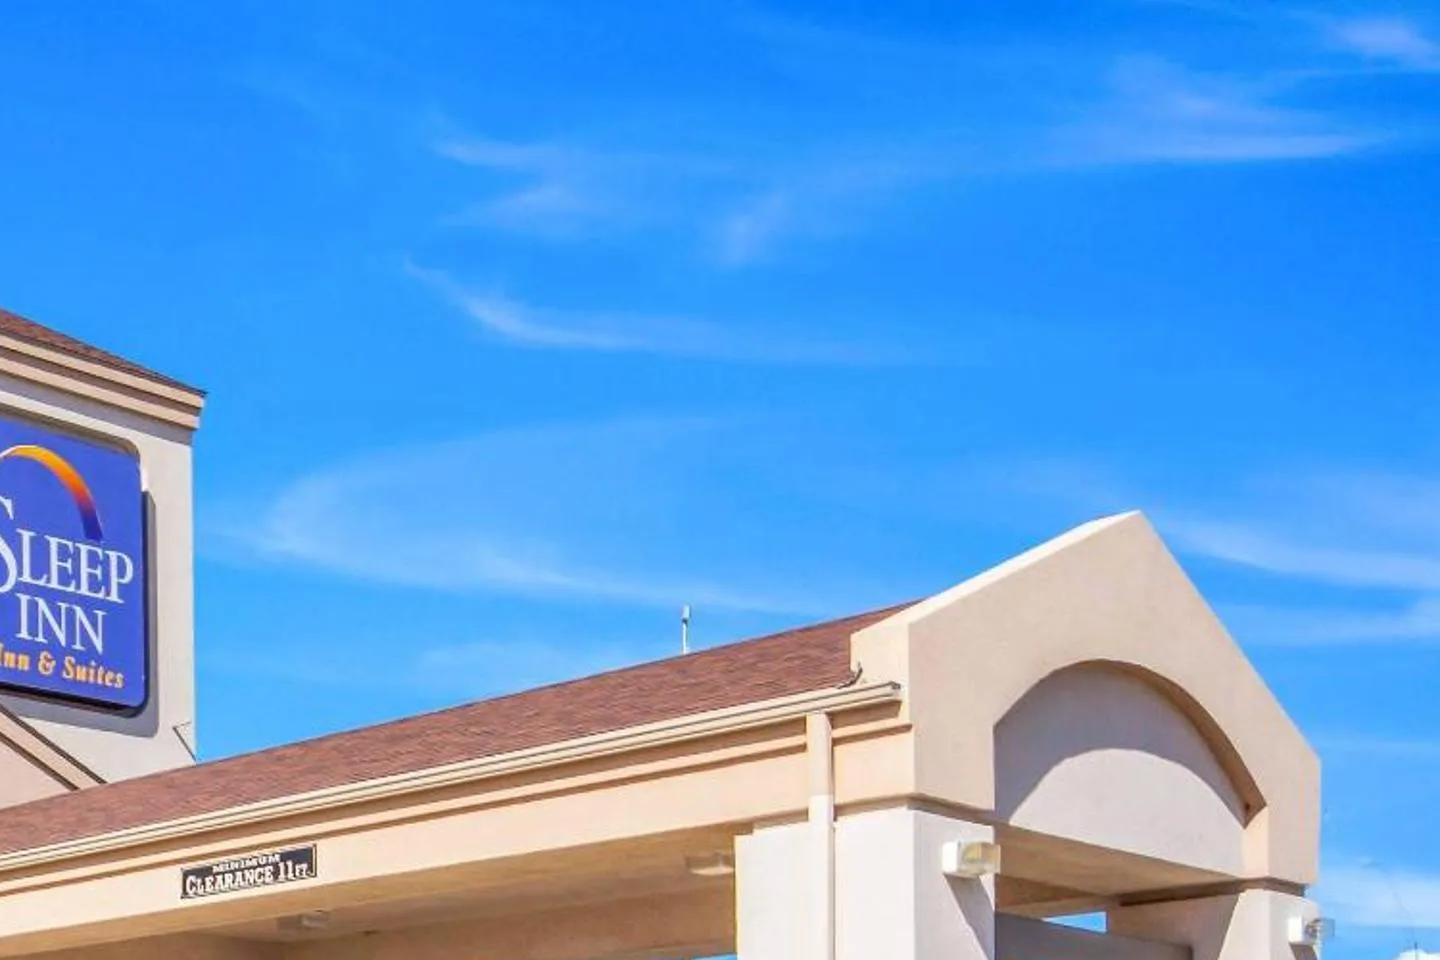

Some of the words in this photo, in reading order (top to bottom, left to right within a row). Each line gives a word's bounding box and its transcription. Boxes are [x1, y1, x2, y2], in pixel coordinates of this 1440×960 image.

[15, 593, 107, 655] INN
[38, 651, 56, 675] &
[62, 656, 124, 688] Suites
[212, 853, 281, 874] MINIMUM
[185, 866, 274, 897] CLEARANCE
